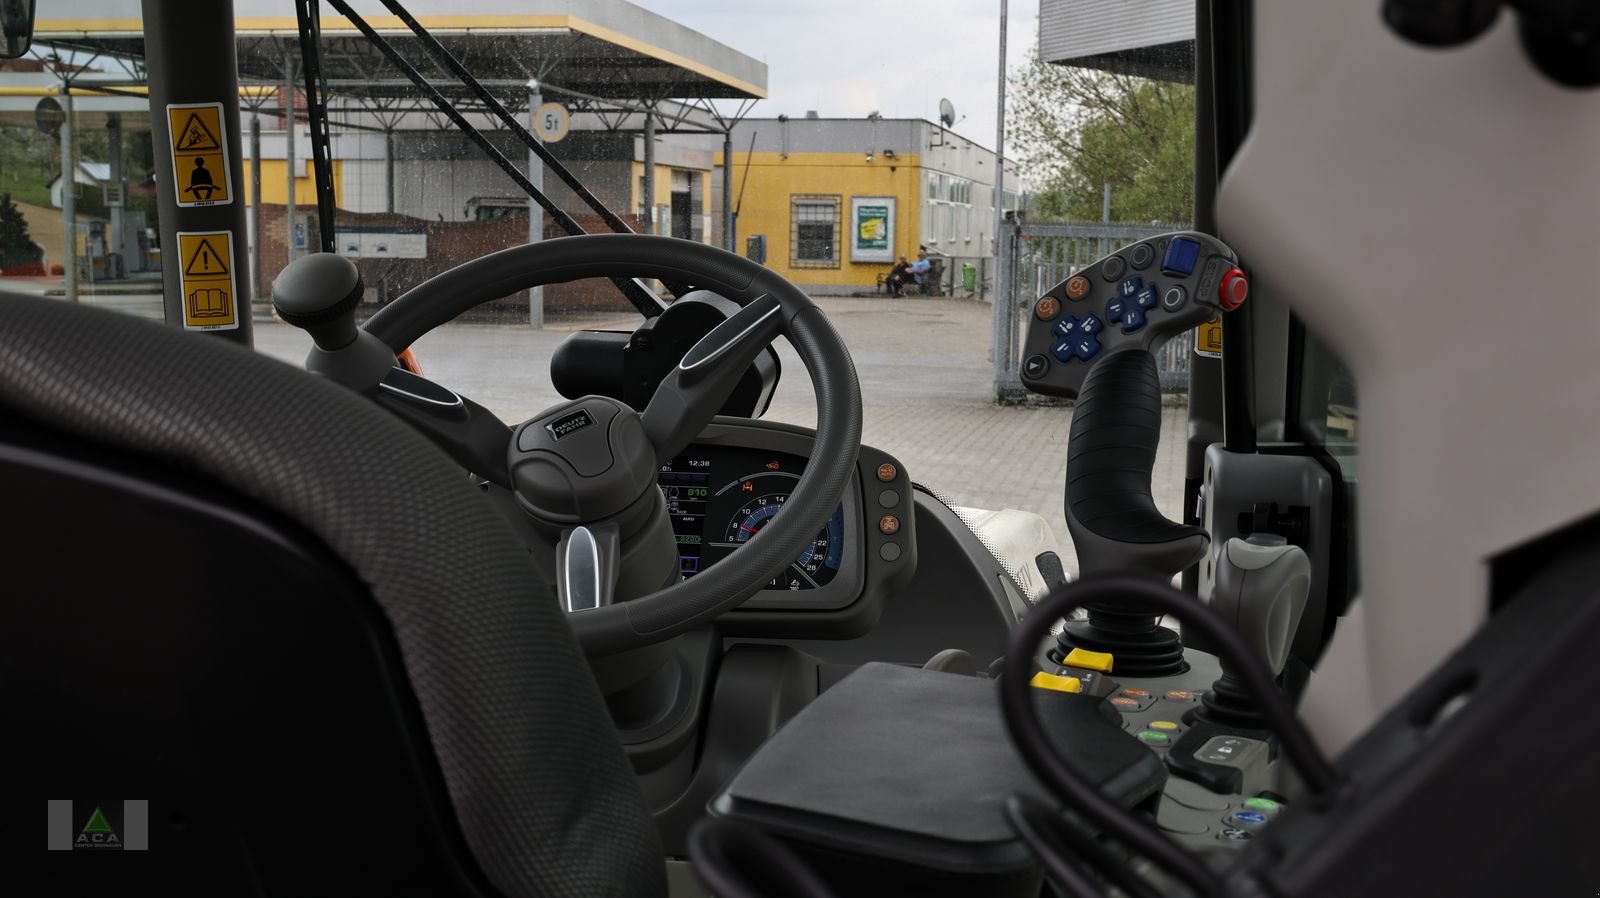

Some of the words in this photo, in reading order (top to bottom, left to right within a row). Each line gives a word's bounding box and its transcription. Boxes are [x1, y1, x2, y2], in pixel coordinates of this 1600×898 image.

[555, 416, 586, 431] DEUTZ
[561, 421, 585, 434] FAHR
[687, 488, 707, 496] 810
